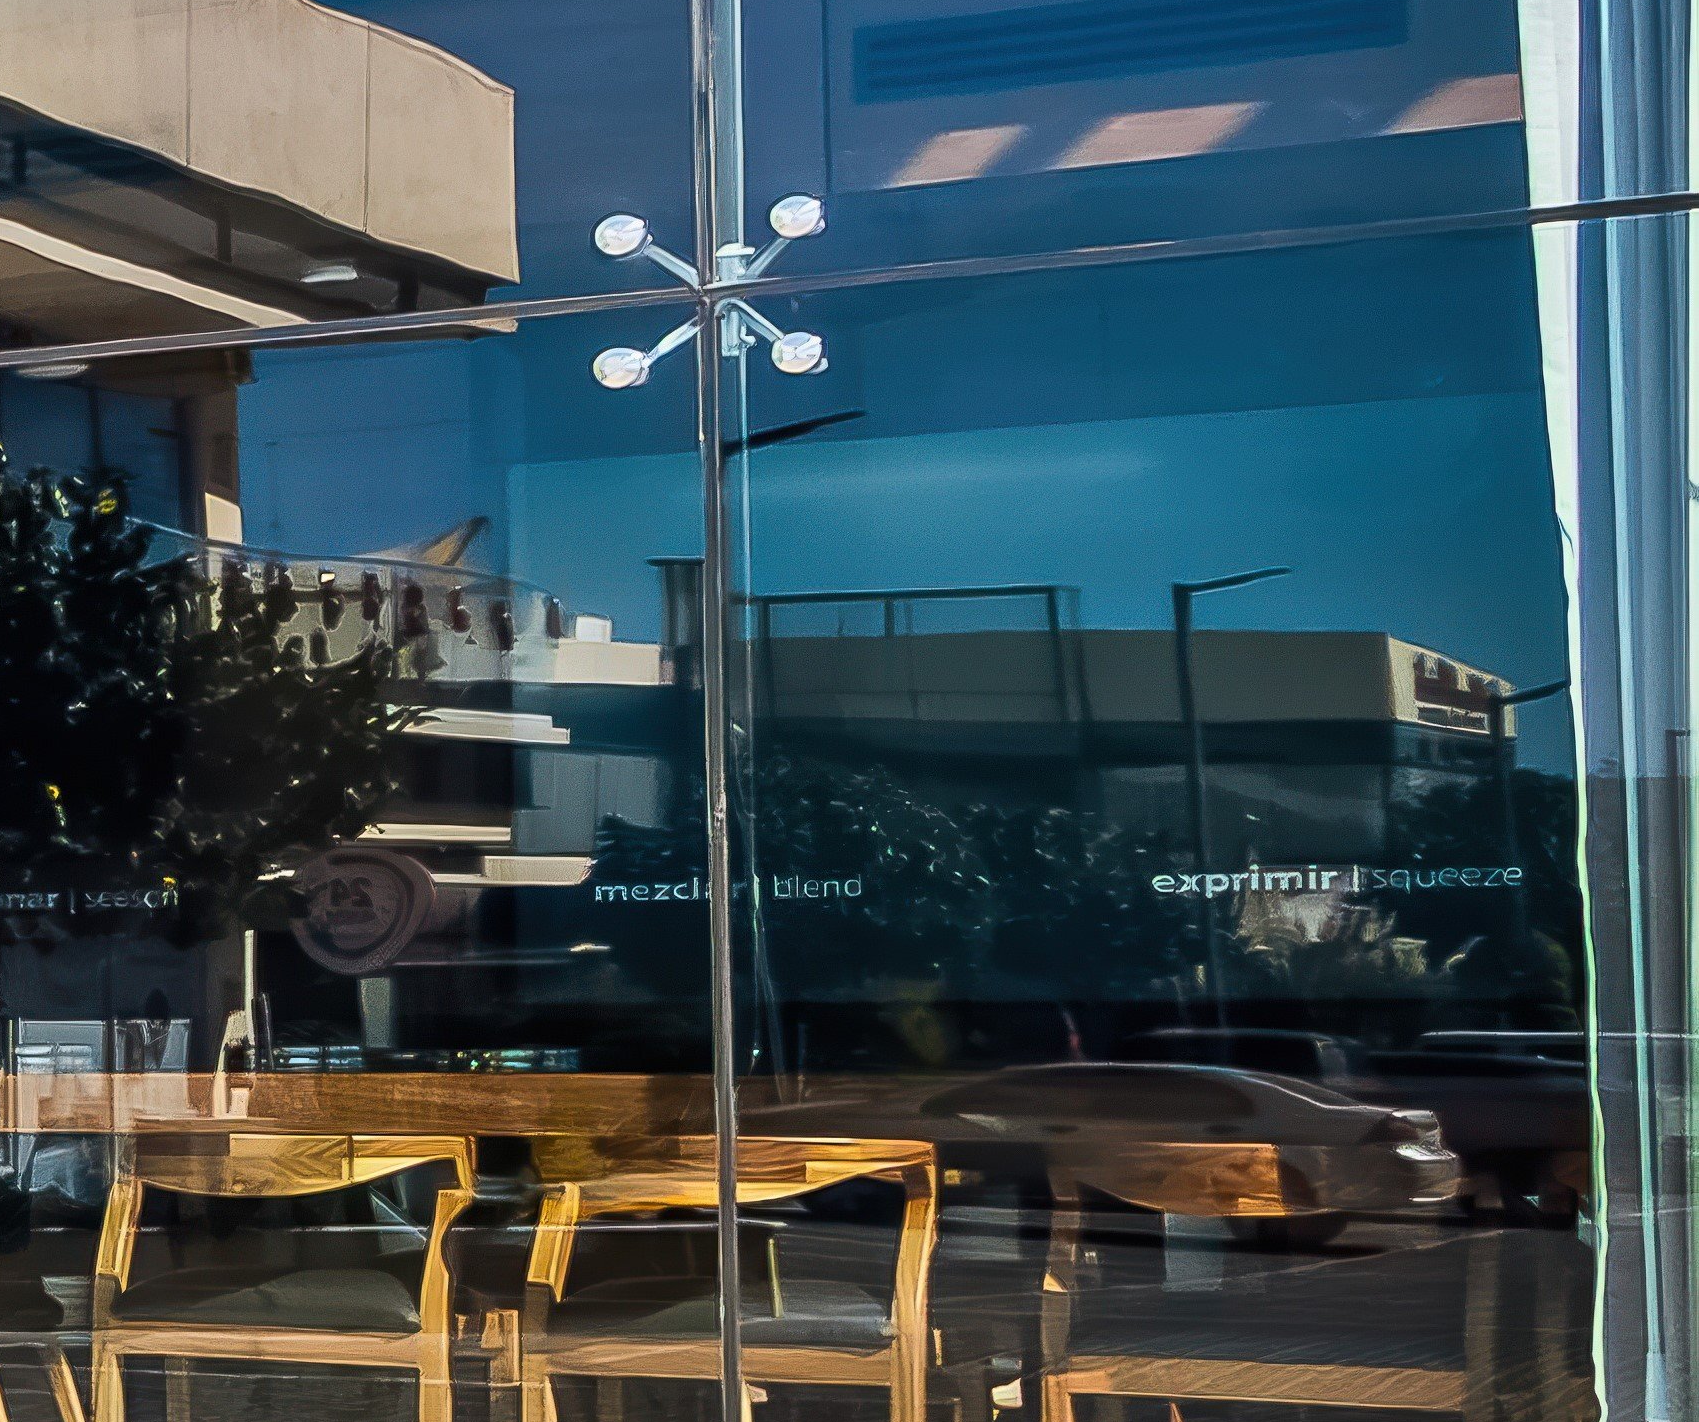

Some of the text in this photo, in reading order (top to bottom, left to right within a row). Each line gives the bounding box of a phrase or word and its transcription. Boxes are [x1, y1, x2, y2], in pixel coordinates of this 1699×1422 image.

[595, 874, 862, 902] mezclr blend
[1152, 864, 1522, 899] exprimir squeeze
